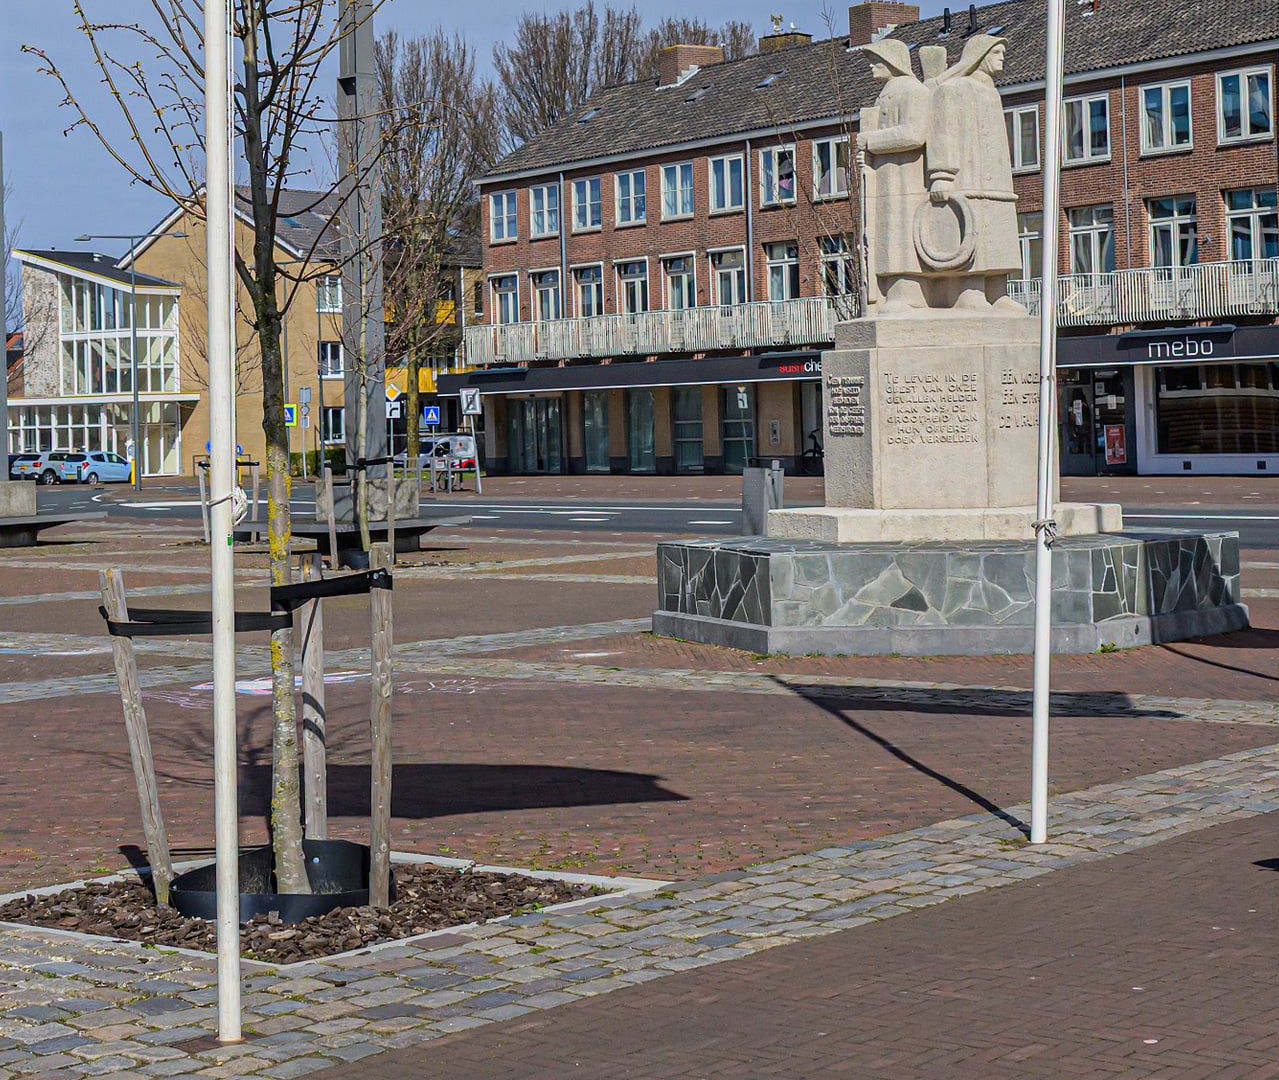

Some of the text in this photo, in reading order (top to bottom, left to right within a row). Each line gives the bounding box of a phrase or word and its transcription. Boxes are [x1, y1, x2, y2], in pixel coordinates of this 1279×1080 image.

[1148, 336, 1213, 358] mebo
[778, 358, 822, 374] sushiche
[904, 375, 939, 384] LEVEN
[944, 374, 956, 382] IN
[961, 374, 977, 382] DE
[886, 384, 977, 394] GEEST VAN ONZE
[886, 394, 978, 404] GEVALLEN HELDEN
[897, 405, 918, 414] KAN
[952, 405, 967, 413] DE
[887, 414, 978, 424] GROOTHEID VAN
[897, 425, 968, 434] HUN OFFERS
[887, 437, 915, 445] DOEN
